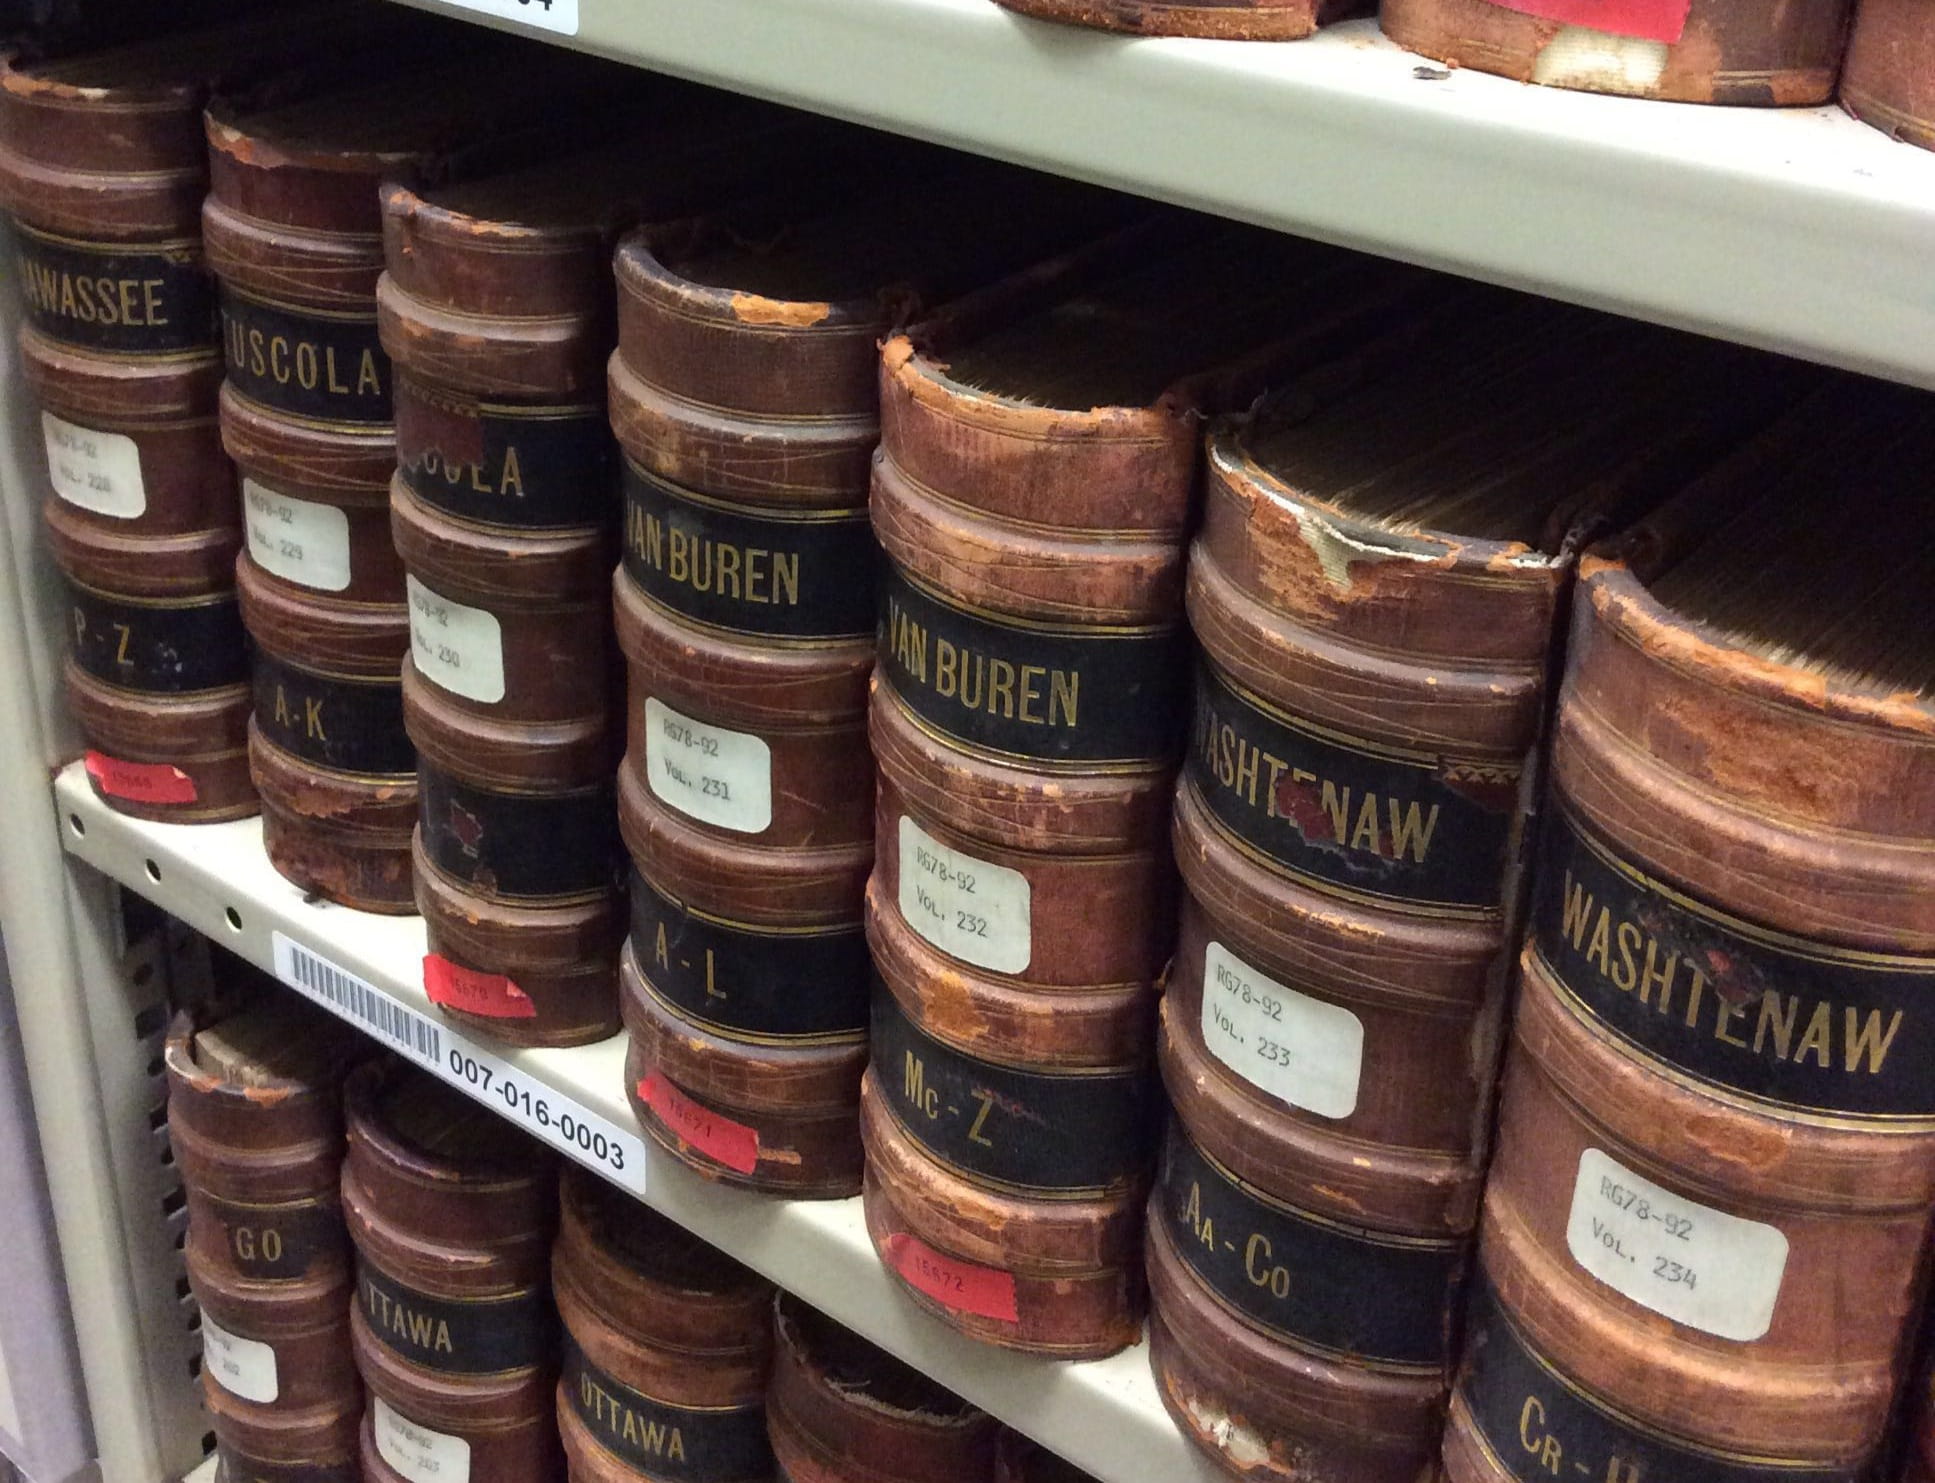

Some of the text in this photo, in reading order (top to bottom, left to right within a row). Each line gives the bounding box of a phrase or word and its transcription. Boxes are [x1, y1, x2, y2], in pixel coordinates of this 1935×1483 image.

[222, 308, 381, 395] USCOLA
[669, 527, 799, 606] BUREN
[890, 596, 1079, 727] VAN BUREN
[702, 776, 731, 801] 231
[956, 910, 989, 938] 232
[1216, 963, 1283, 1023] RG78-92
[1562, 867, 1904, 1074] WASHTENAW
[1257, 1036, 1292, 1068] 233
[449, 1049, 626, 1171] 007-016-0003
[1600, 1175, 1694, 1242] RG78-92
[362, 1270, 453, 1354] TTAWA
[1652, 1255, 1698, 1292] 234
[580, 1370, 686, 1463] OTTAWA
